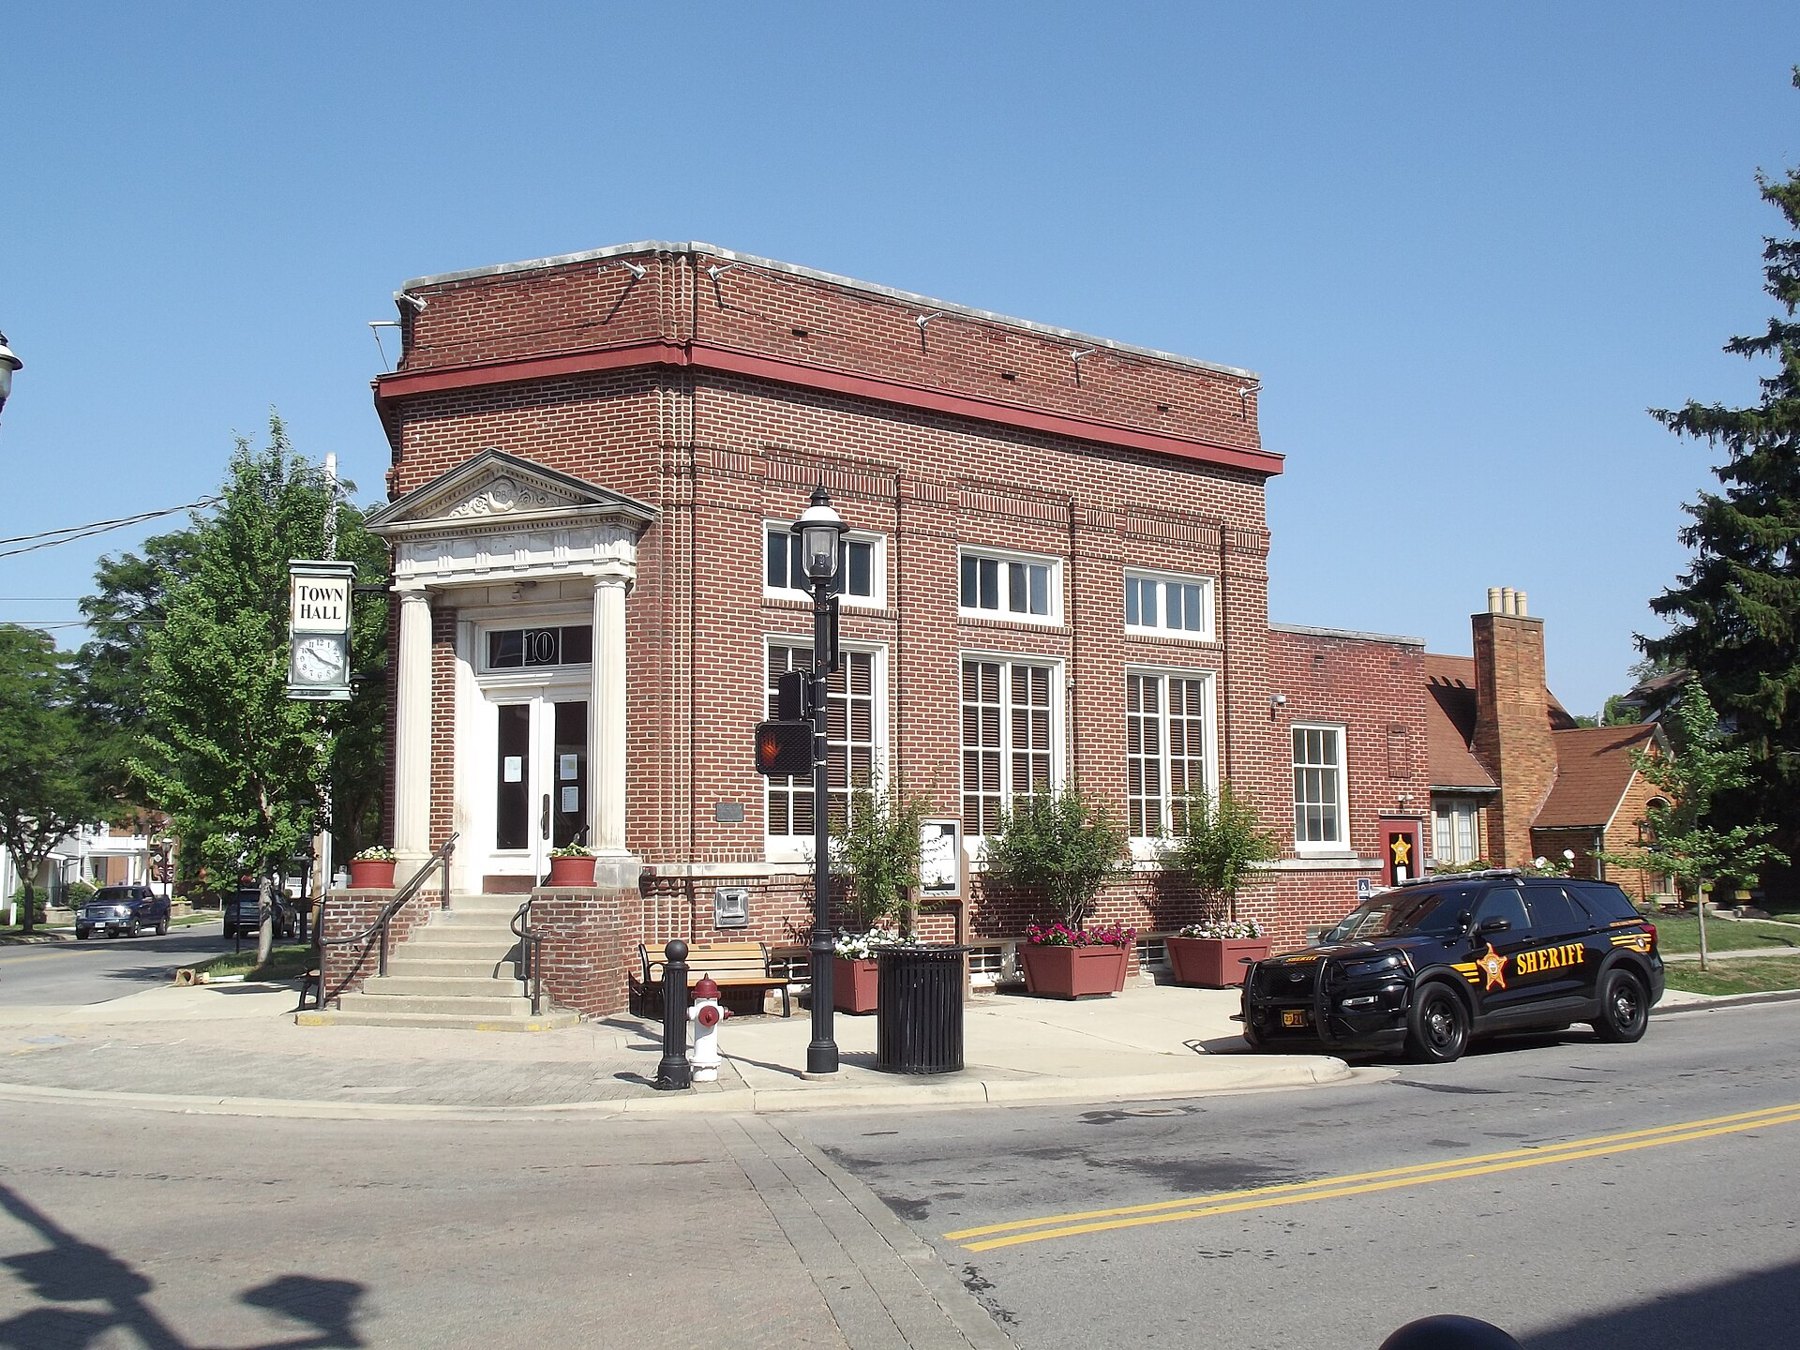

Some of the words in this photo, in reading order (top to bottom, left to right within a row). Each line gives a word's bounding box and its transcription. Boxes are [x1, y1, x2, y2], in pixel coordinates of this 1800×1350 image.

[299, 585, 343, 602] TOWN
[301, 604, 341, 620] HALL
[523, 631, 555, 663] 10
[317, 671, 323, 679] 6
[1516, 942, 1585, 975] SHERIFF
